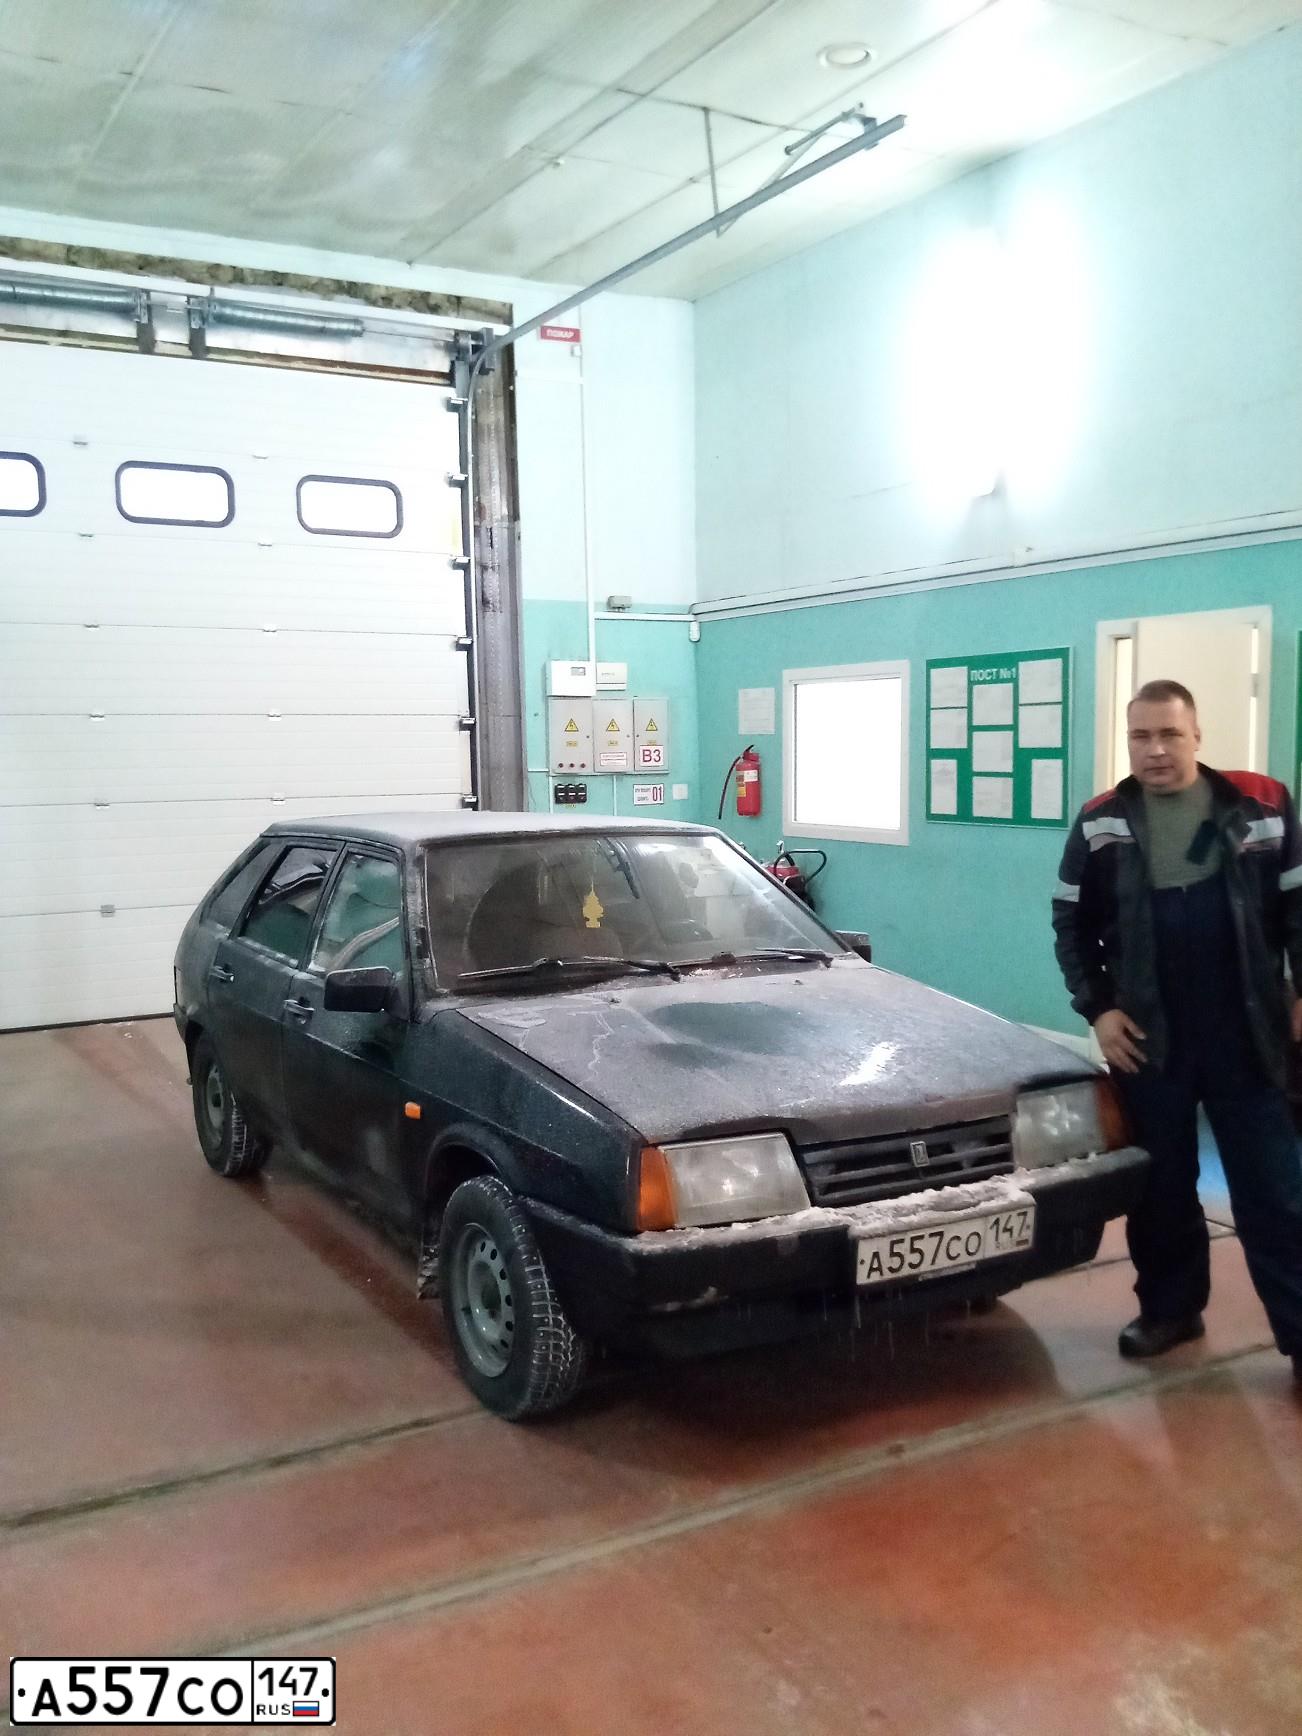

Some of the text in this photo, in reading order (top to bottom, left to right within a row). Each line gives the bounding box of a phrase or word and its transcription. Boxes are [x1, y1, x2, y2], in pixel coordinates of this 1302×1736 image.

[970, 668, 998, 681] ПОСТ
[652, 786, 662, 802] 01
[866, 1211, 1028, 1279] А557СО 147
